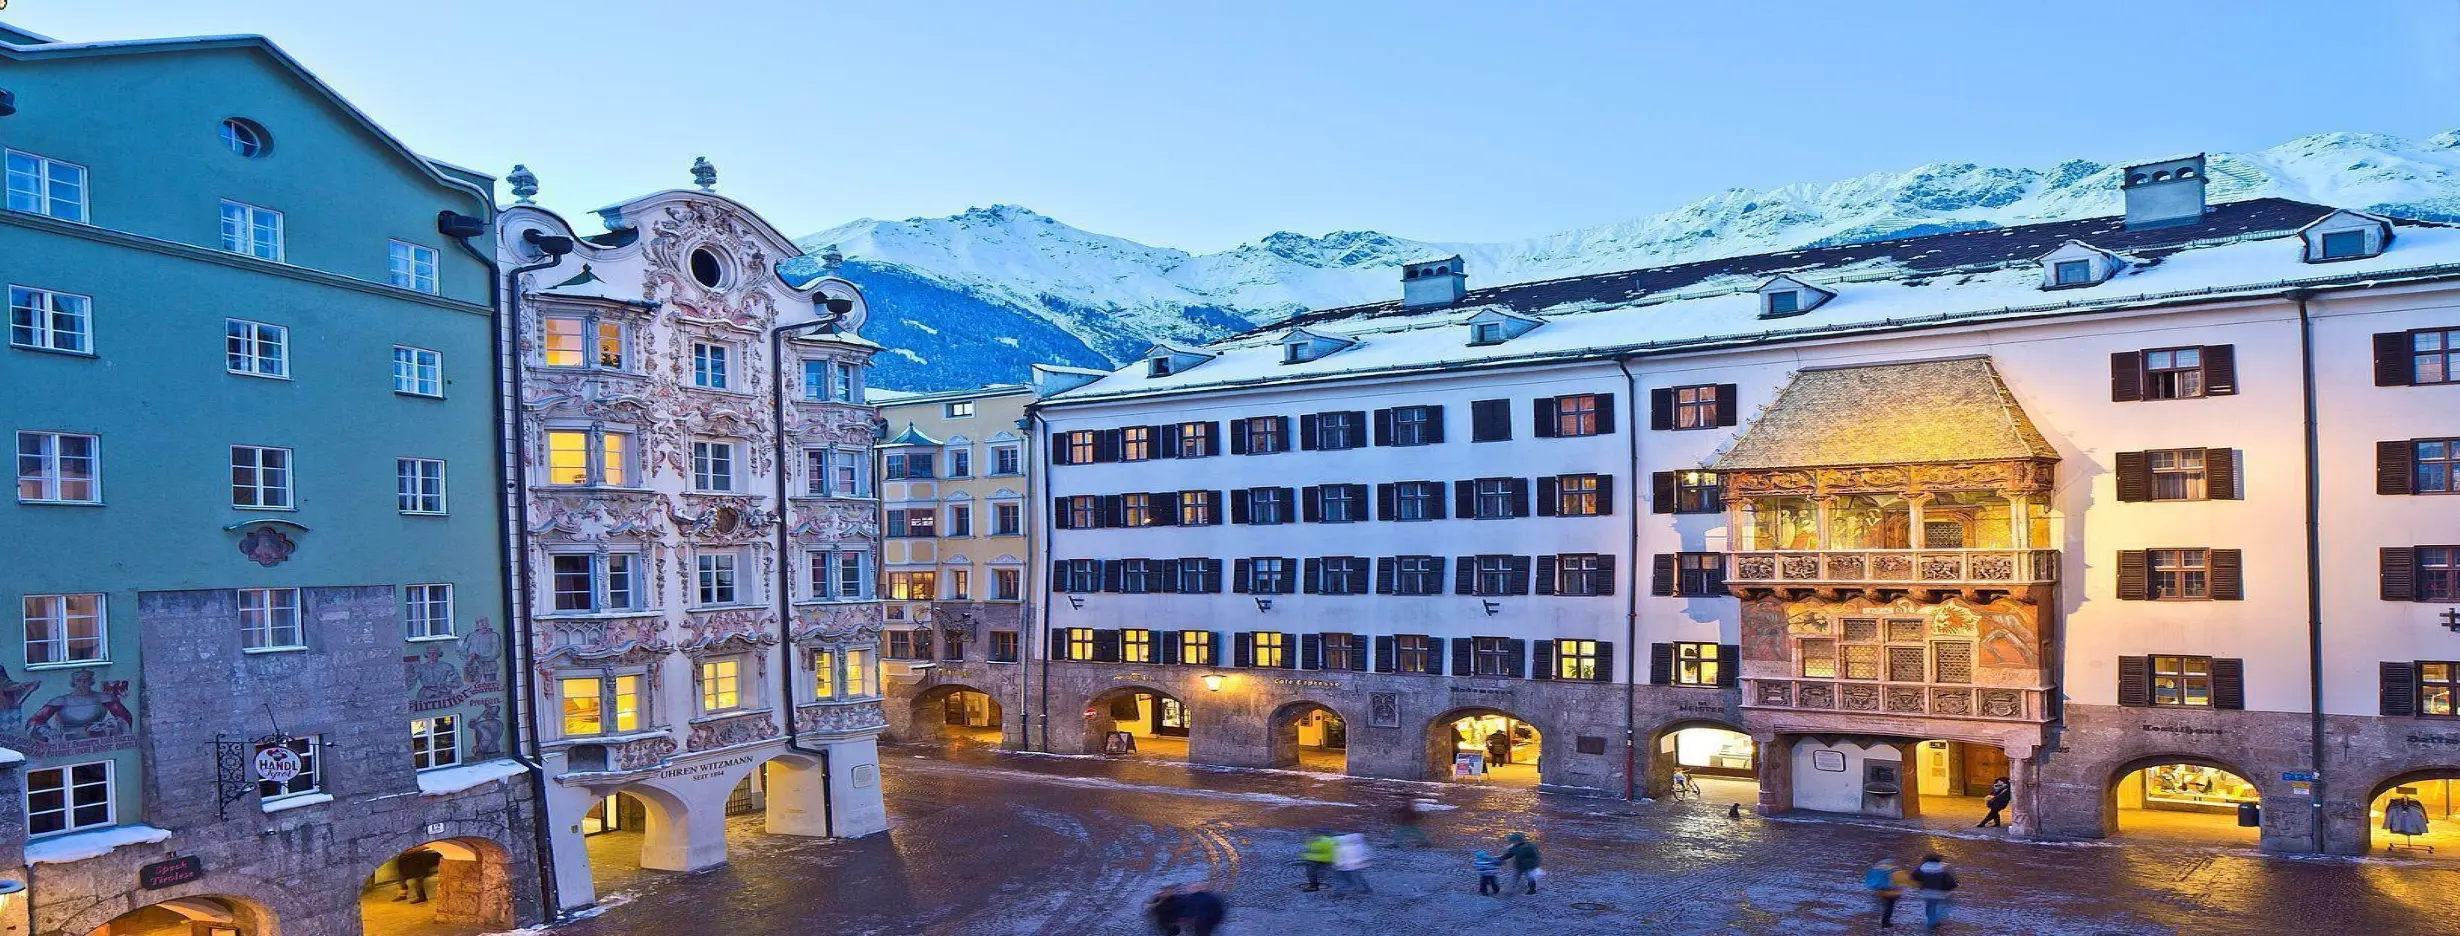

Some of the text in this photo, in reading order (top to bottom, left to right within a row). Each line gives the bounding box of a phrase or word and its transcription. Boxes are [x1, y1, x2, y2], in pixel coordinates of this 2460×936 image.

[259, 759, 297, 771] HANDL
[660, 755, 754, 779] UHREN WITZMANN
